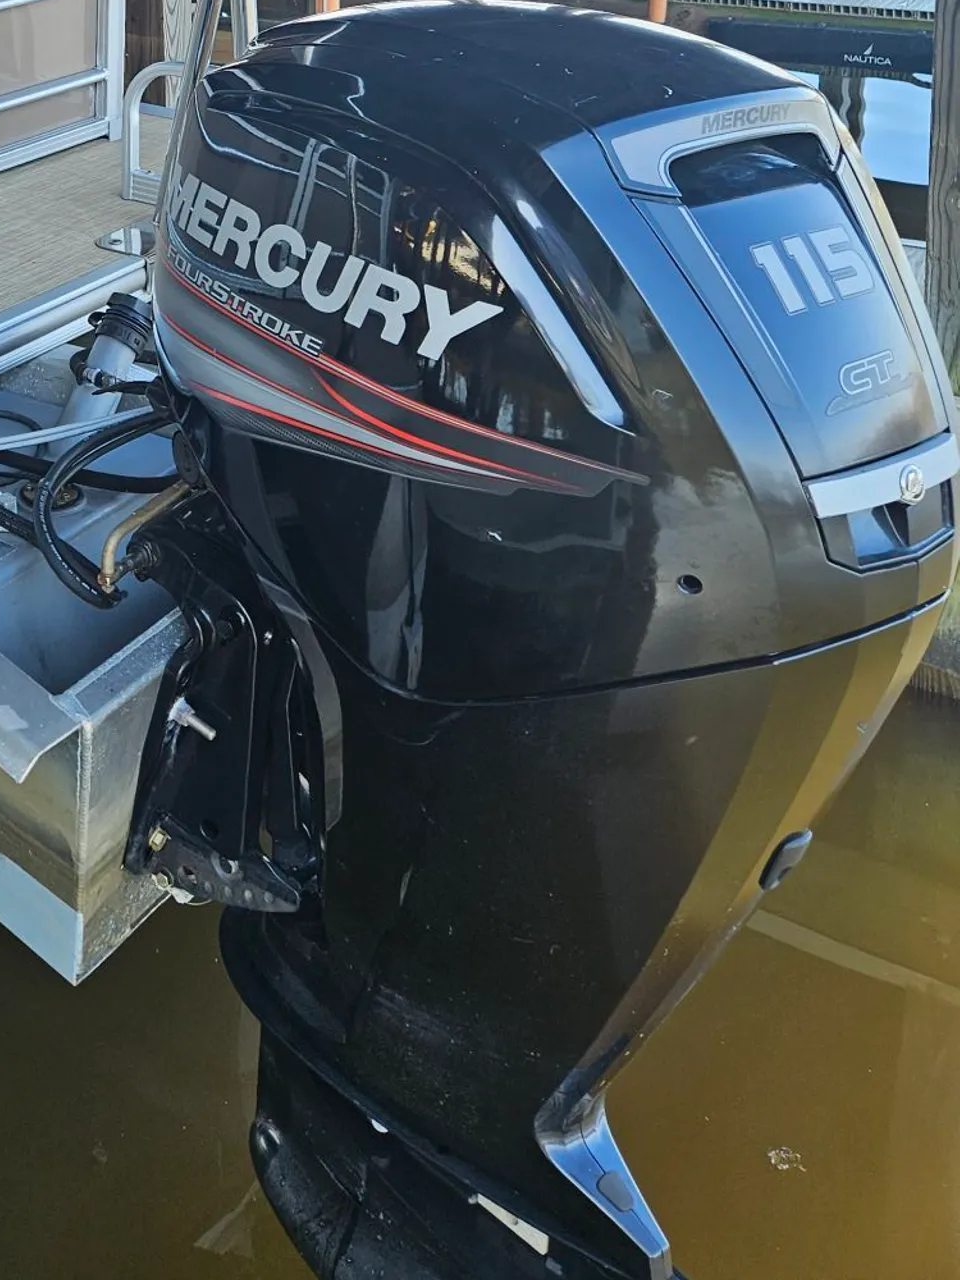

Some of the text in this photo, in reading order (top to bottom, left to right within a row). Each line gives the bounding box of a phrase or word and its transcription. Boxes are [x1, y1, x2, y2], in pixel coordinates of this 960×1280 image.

[843, 54, 892, 66] NAUTICA
[701, 103, 792, 134] MERCURY
[166, 243, 324, 357] FOURSTROKE
[170, 164, 505, 362] MERCURY
[749, 223, 876, 316] 115
